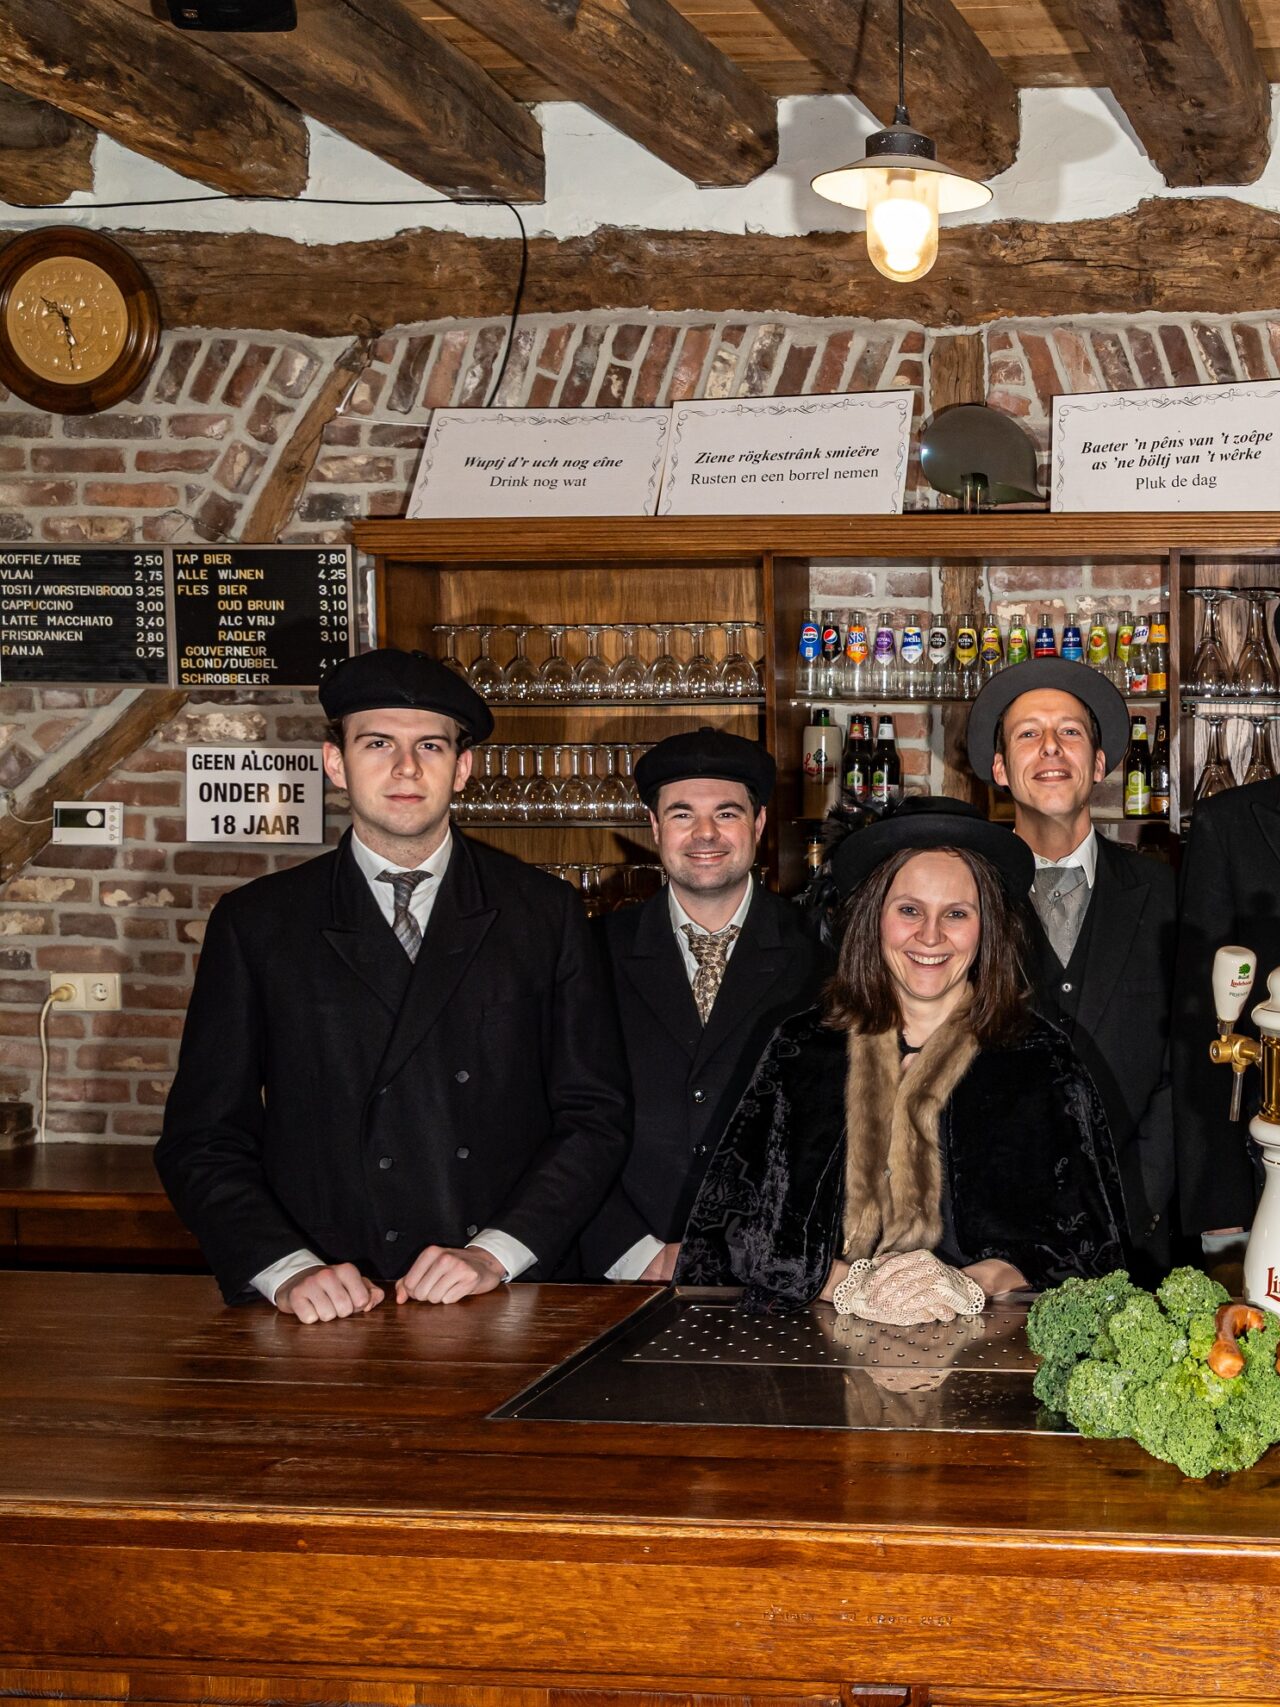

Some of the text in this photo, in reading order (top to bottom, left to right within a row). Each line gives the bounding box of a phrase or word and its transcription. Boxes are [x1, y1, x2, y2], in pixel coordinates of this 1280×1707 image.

[1081, 440, 1128, 454] Baeter
[1150, 436, 1185, 453] pêns
[1189, 436, 1213, 447] van
[1233, 430, 1273, 446] zoêpe
[694, 451, 735, 464] Ziene
[825, 445, 879, 459] smieëre
[1091, 459, 1107, 470] as
[1114, 456, 1135, 469] ’ne
[1139, 452, 1171, 469] böltj
[1176, 452, 1200, 464] van
[1220, 447, 1262, 461] wêrke
[464, 455, 623, 471] Wuptj d’r uch nog eîne
[490, 475, 587, 490] Drink nog wat
[690, 468, 879, 485] Rusten en een borrel nemen
[1135, 473, 1217, 490] Pluk de dag
[176, 554, 199, 565] TAP
[203, 554, 232, 565] BIER
[0, 569, 34, 580] VLAAI
[177, 569, 208, 580] ALLE
[217, 569, 264, 580] WIJNEN
[177, 584, 209, 596] FLES
[218, 584, 248, 596] BIER
[1, 600, 74, 611] CAPPUCCINO
[217, 600, 243, 611] OUD
[247, 600, 285, 611] BRUIN
[2, 615, 38, 626] LATTE
[47, 615, 113, 627] MACCHIATO
[219, 615, 243, 626] ALC
[247, 615, 276, 626] VRIJ
[1, 630, 83, 642] FRISDRANKEN
[218, 630, 266, 642] RADLER
[2, 645, 44, 657] RANJA
[185, 646, 267, 657] GOUVERNEUR
[181, 658, 278, 669] BLOND/DUBBEL
[181, 673, 270, 684] SCHROBBELER
[192, 754, 319, 771] GEEN ALCOHOL
[199, 782, 305, 804] ONDER DE
[210, 815, 300, 836] 18 JAAR
